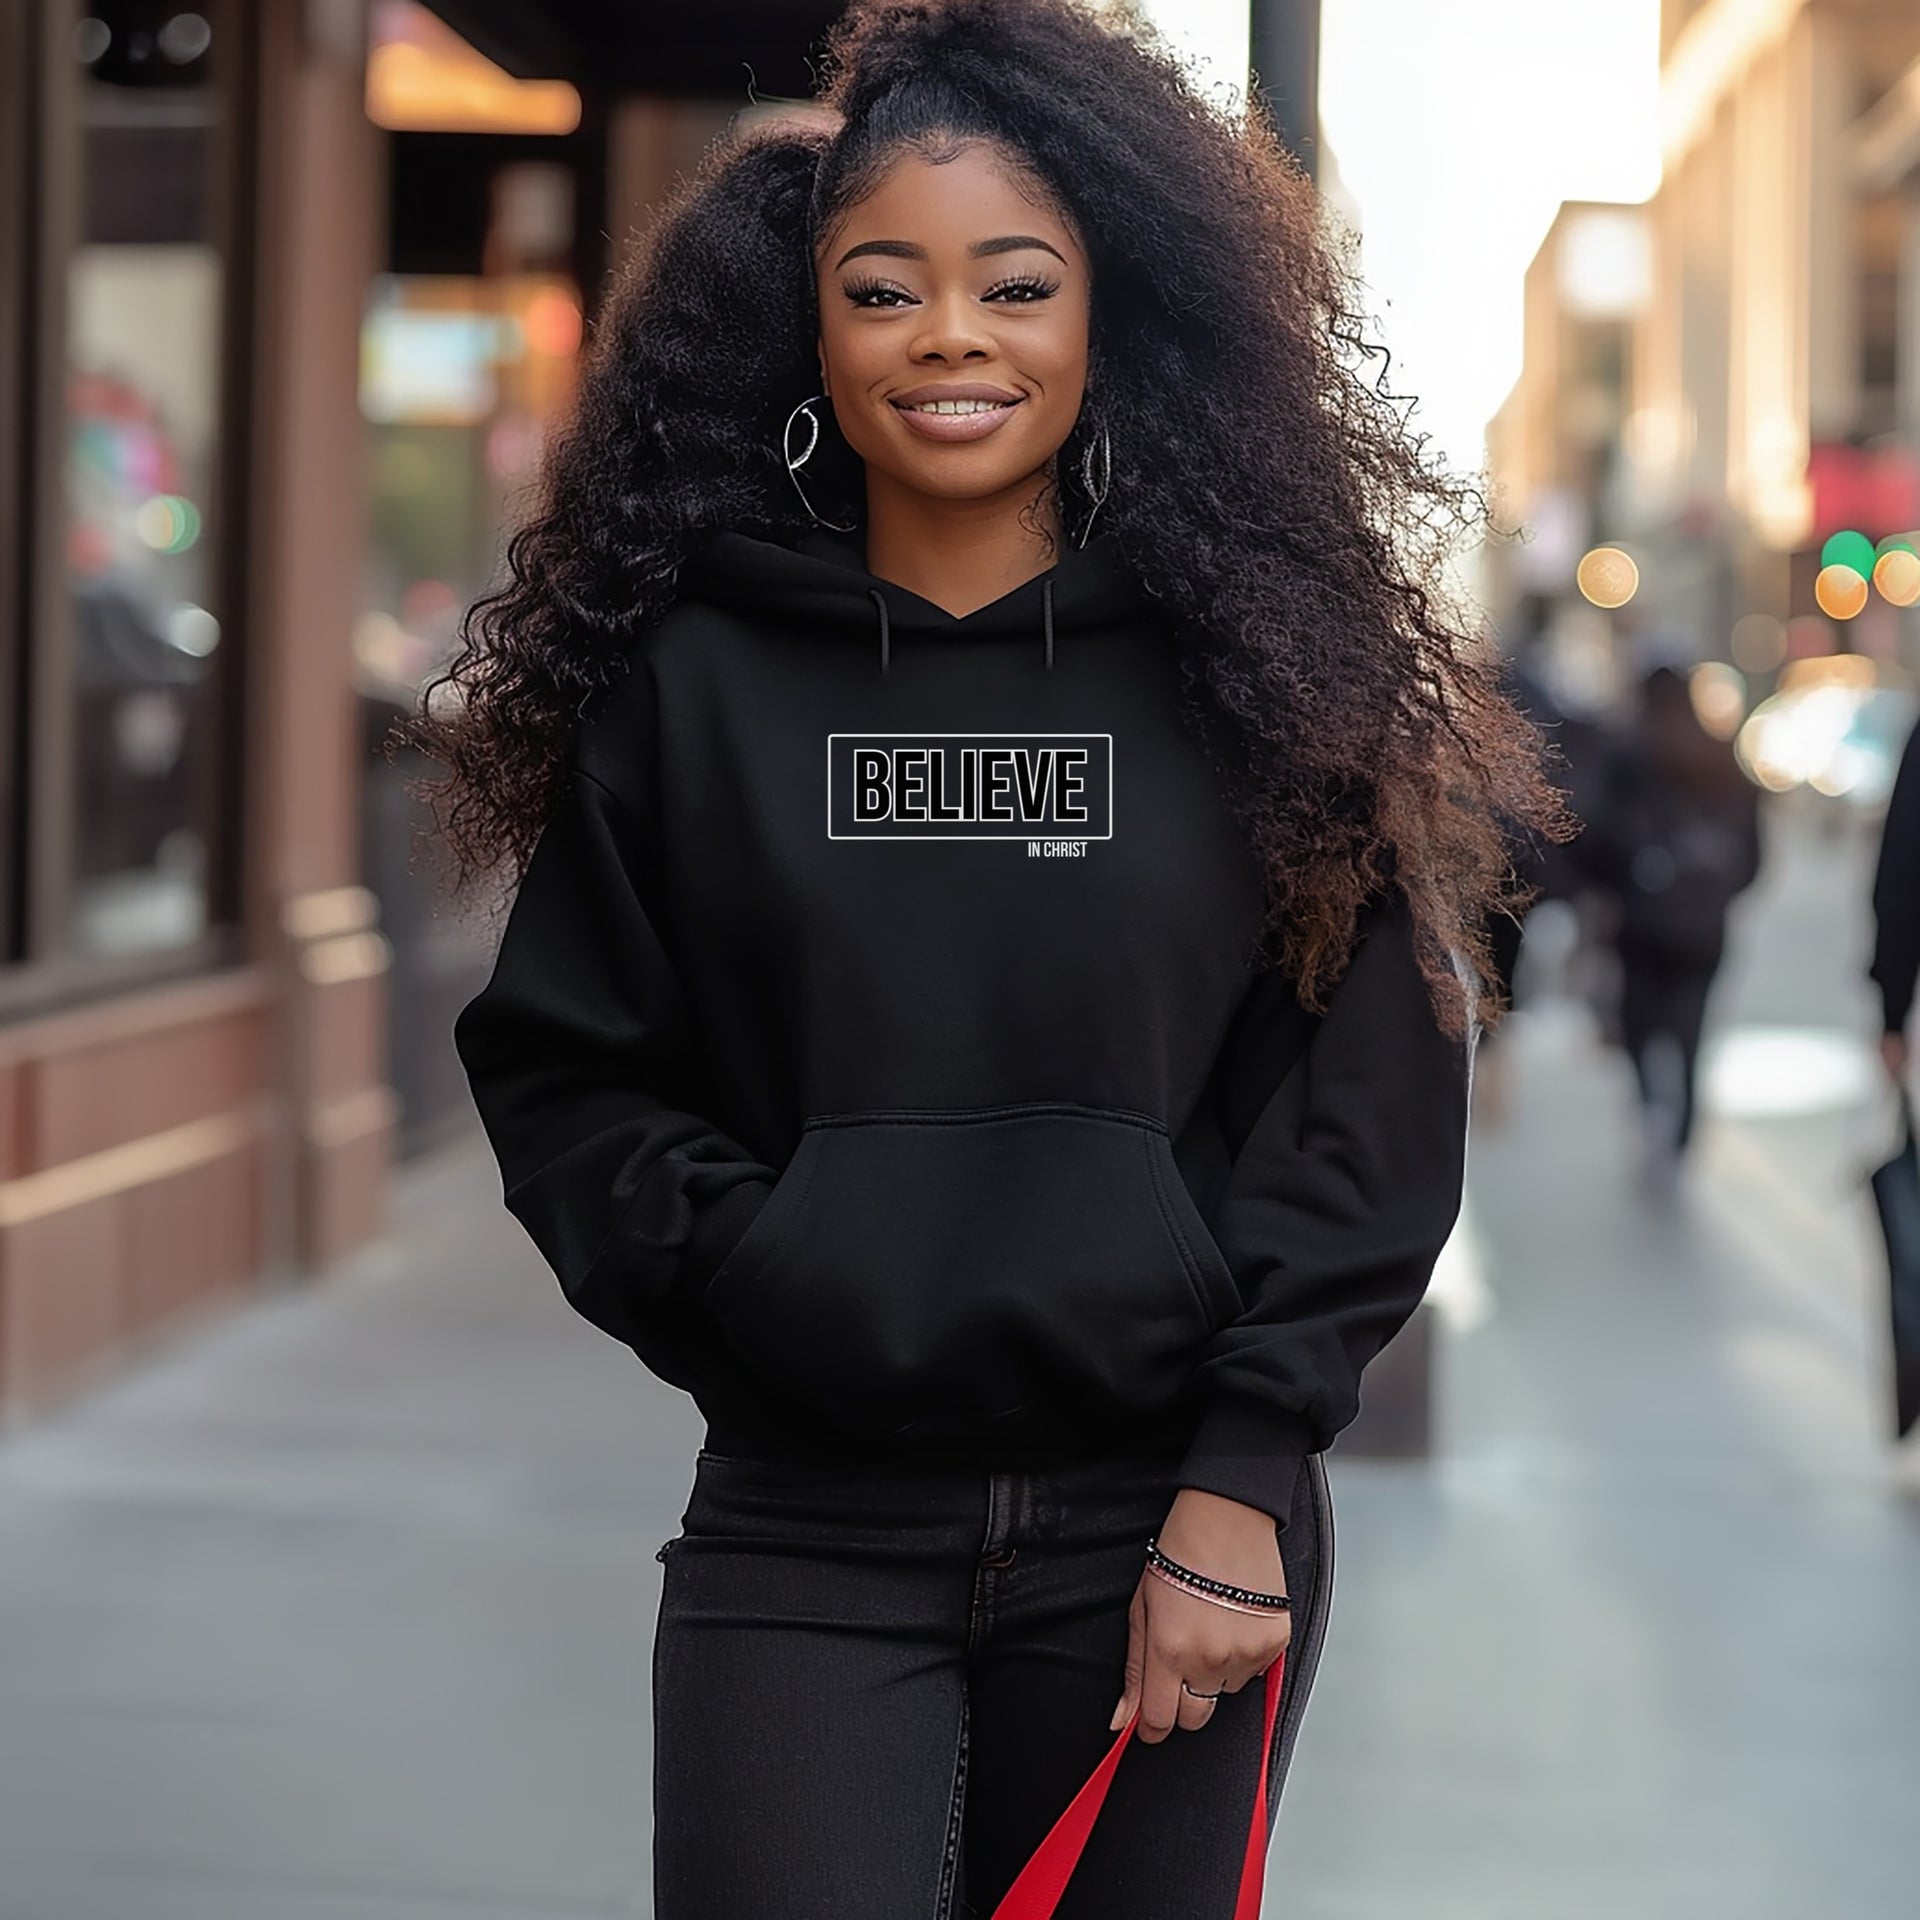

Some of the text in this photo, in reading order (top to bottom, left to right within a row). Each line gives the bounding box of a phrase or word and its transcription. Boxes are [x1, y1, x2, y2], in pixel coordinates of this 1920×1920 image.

[853, 748, 1088, 822] BELIEVE
[1027, 841, 1088, 858] IN CHRIST
